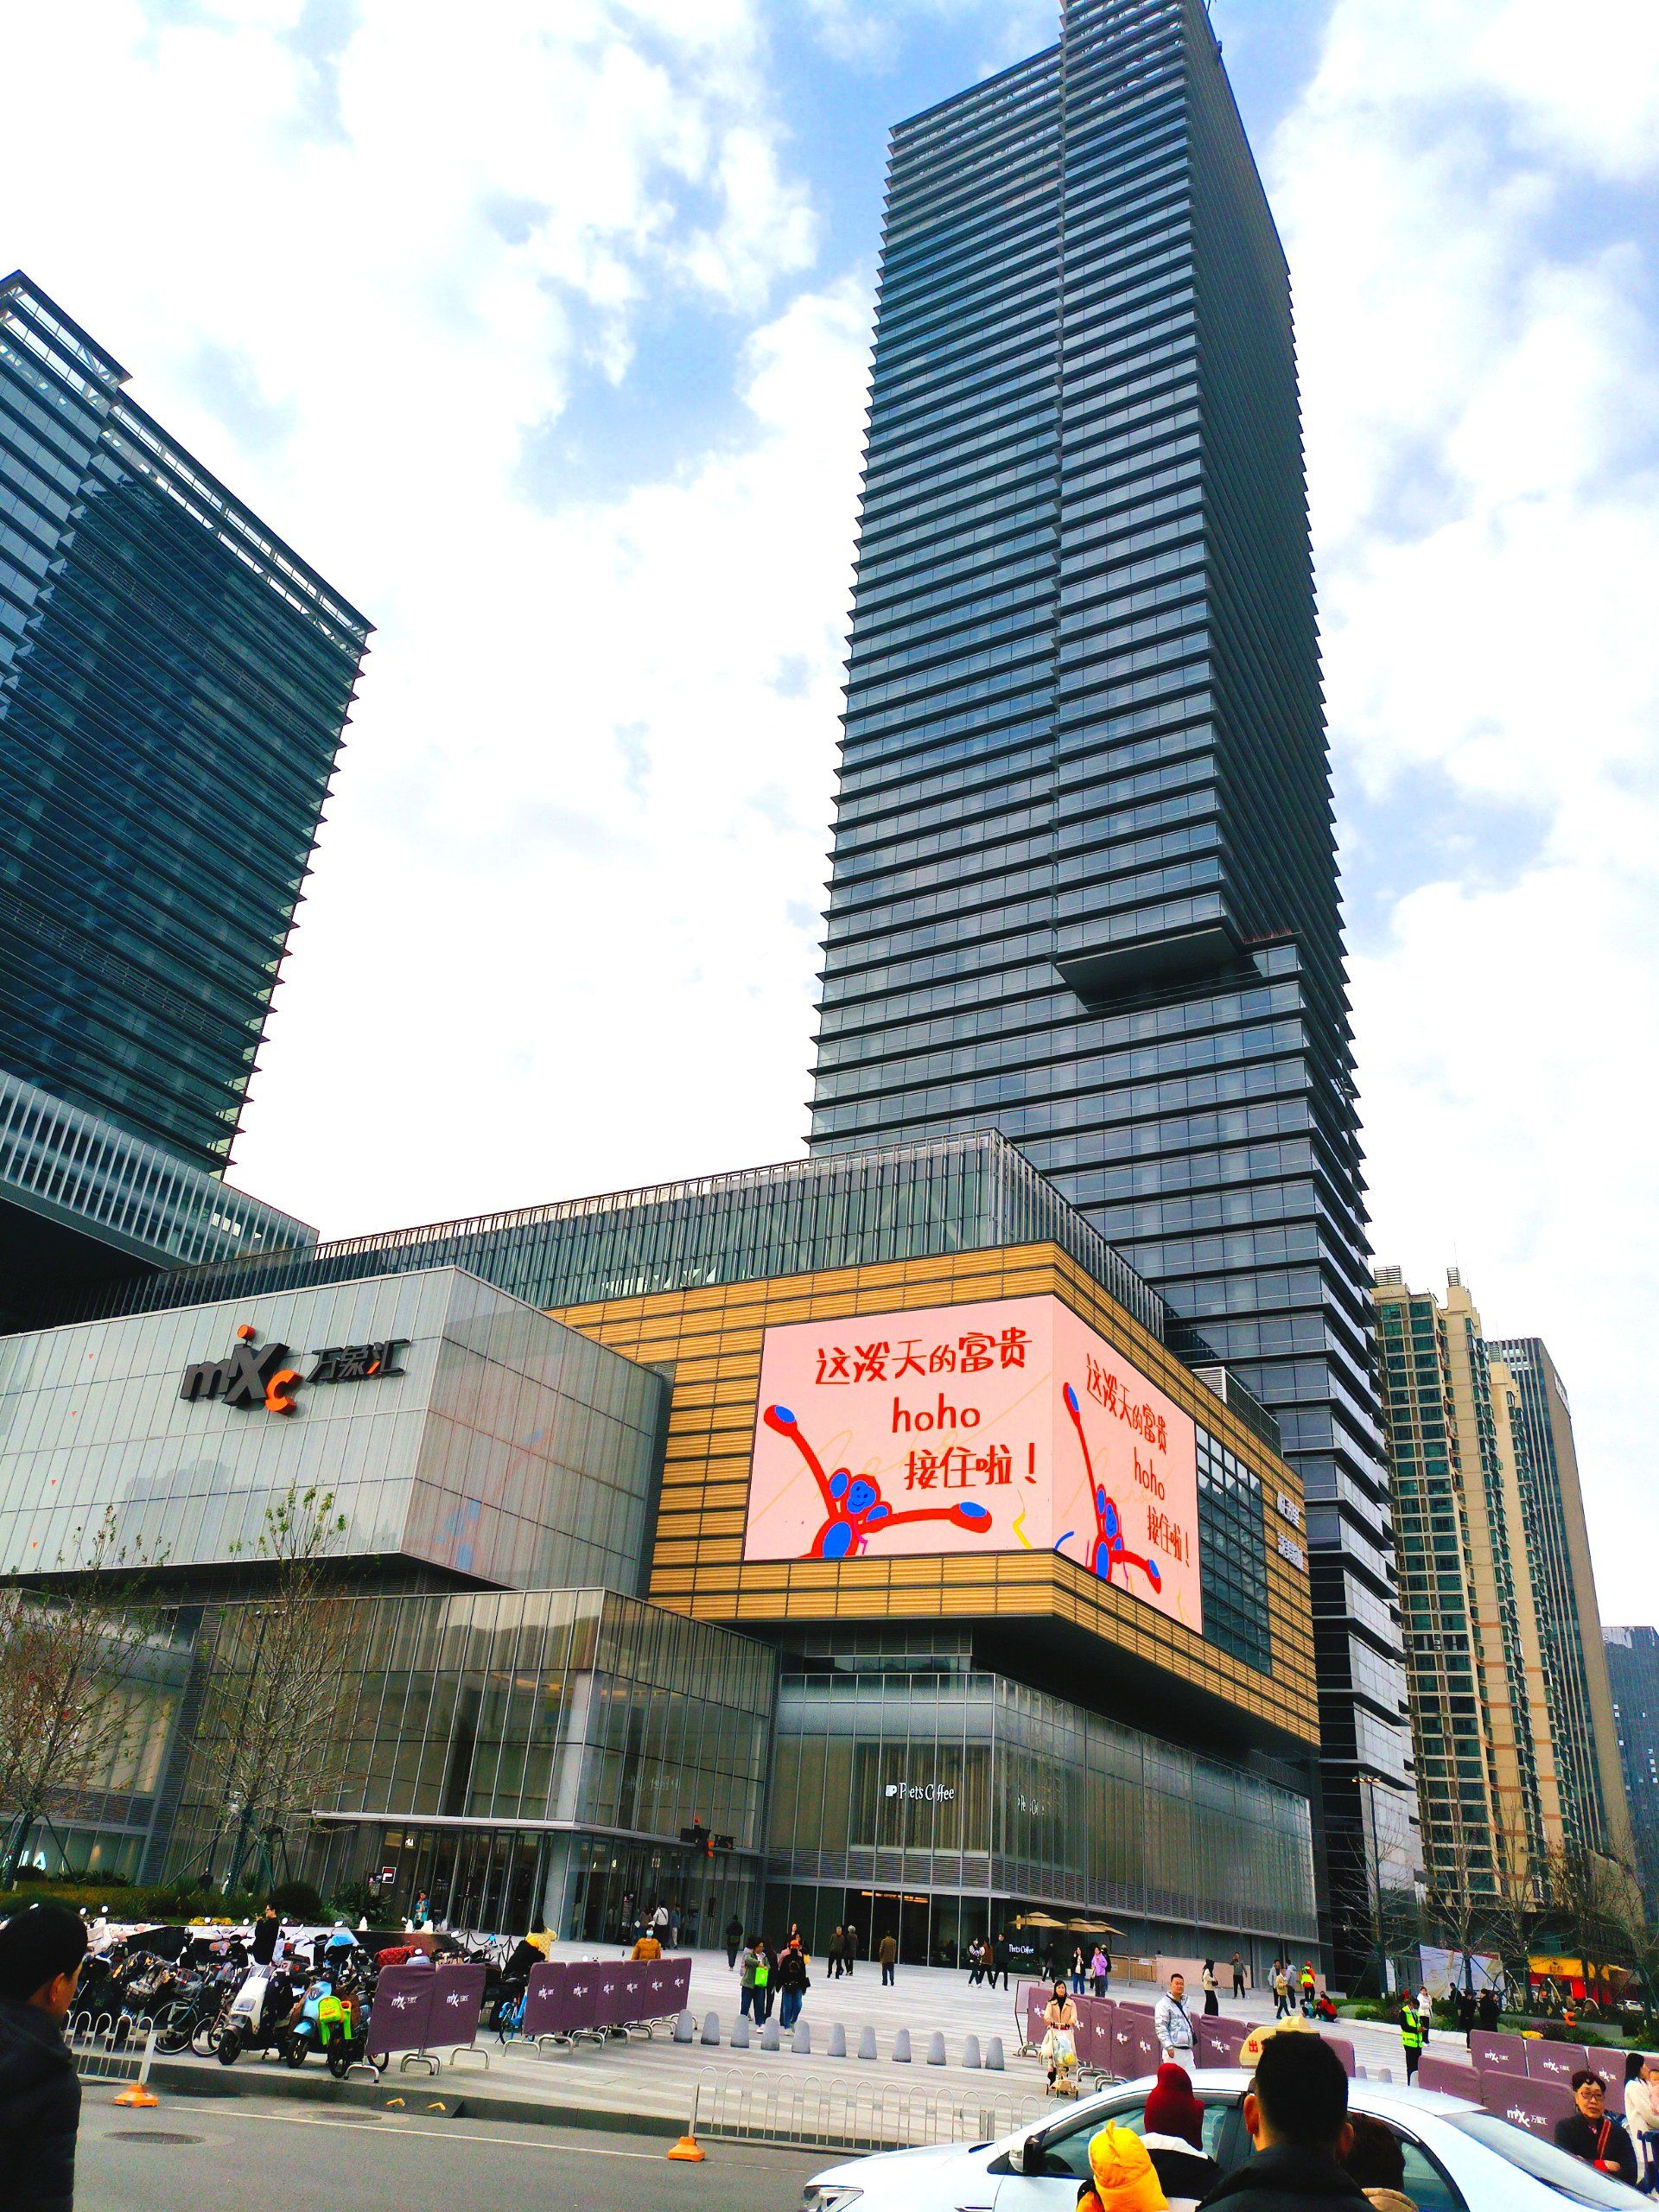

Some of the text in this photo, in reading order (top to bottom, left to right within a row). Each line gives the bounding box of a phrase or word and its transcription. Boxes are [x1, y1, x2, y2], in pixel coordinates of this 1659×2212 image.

[305, 1338, 411, 1383] 万象汇
[816, 1327, 1032, 1384] 这泼天的富贵
[892, 1393, 980, 1433] hoho
[1086, 1353, 1168, 1455] 这泼天的富贵
[904, 1442, 1037, 1491] 接住啦！
[1134, 1446, 1165, 1501] hoho
[1147, 1505, 1190, 1567] 接住啦！
[925, 1783, 955, 1802] Cffee
